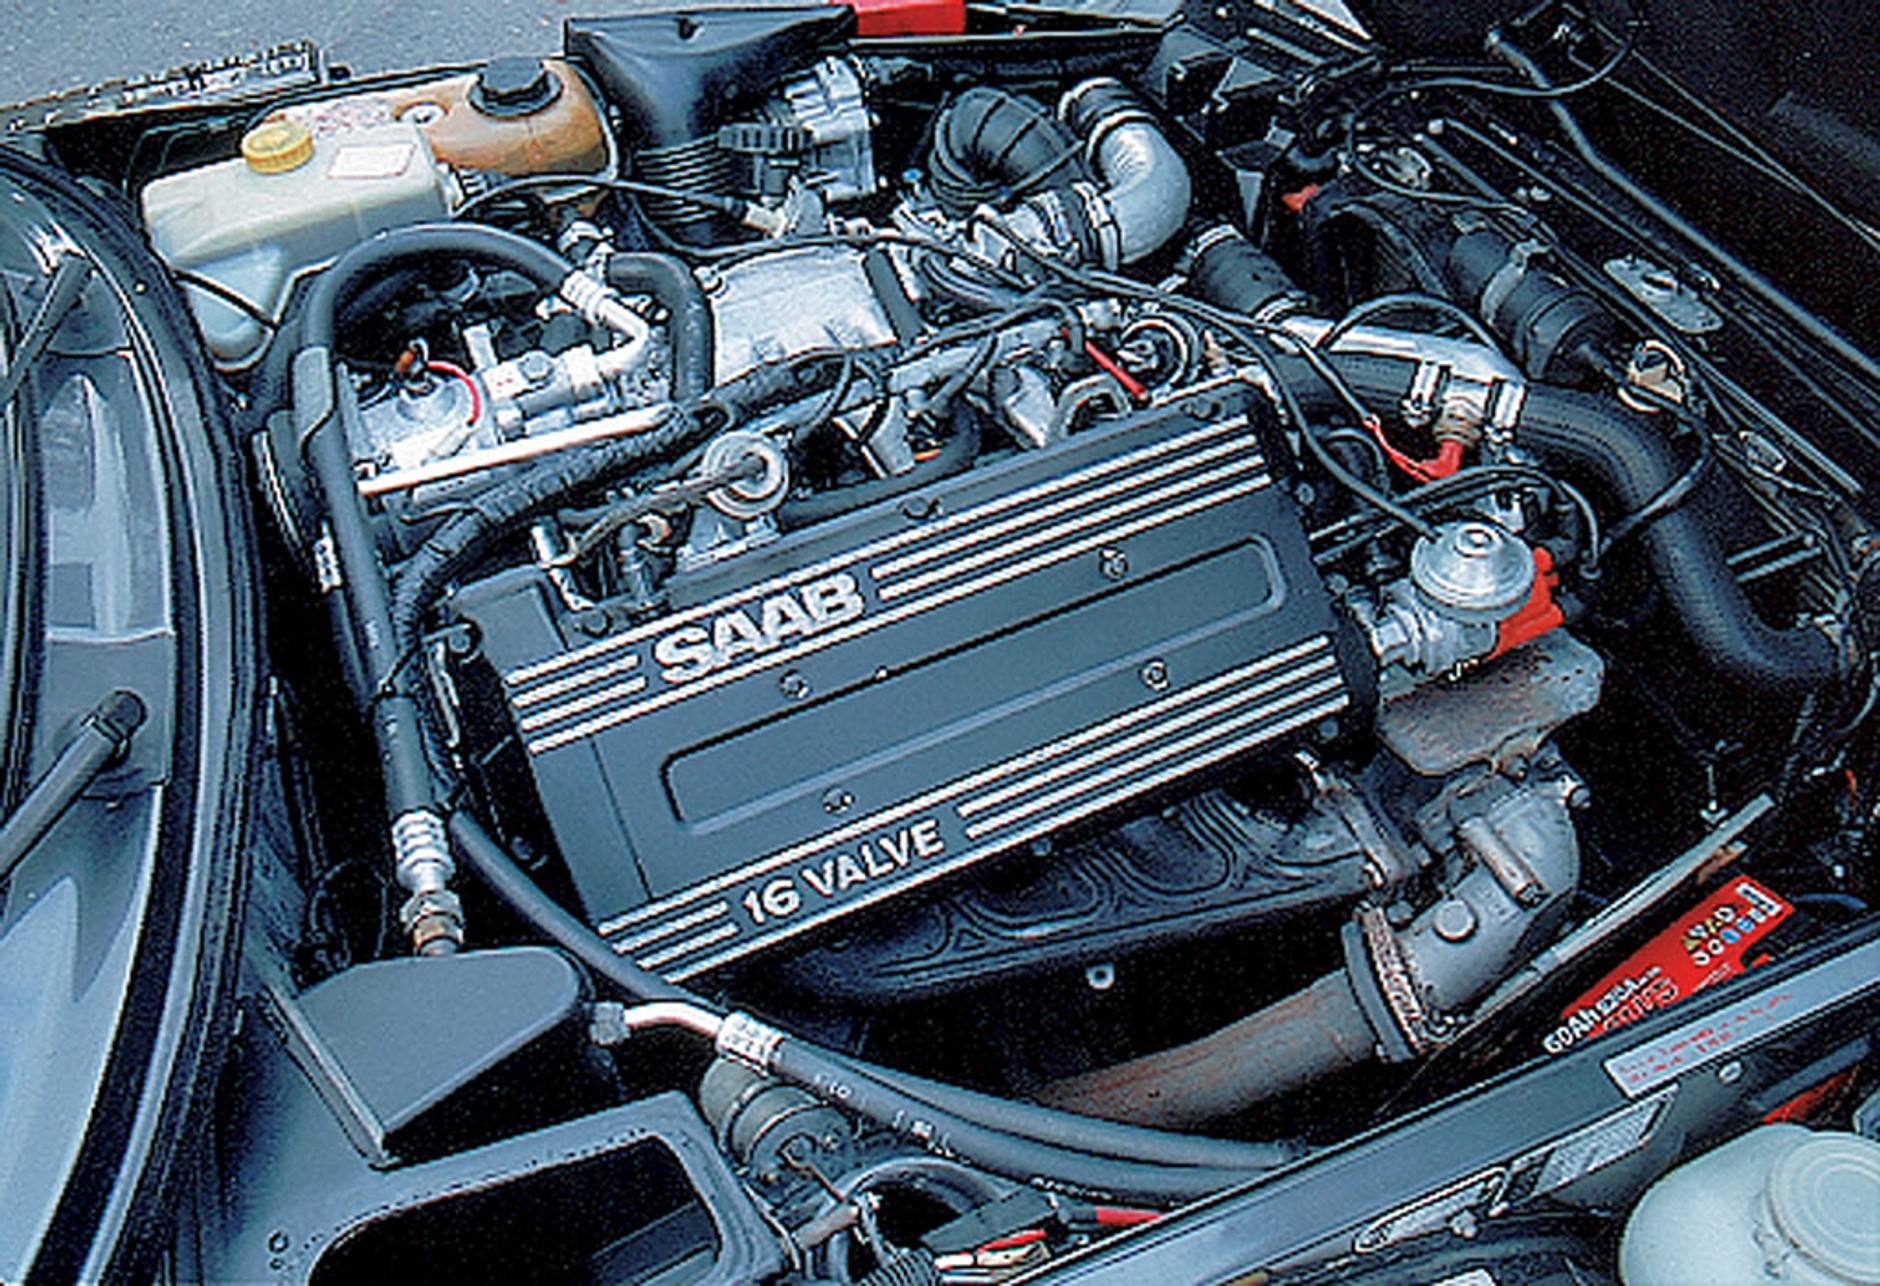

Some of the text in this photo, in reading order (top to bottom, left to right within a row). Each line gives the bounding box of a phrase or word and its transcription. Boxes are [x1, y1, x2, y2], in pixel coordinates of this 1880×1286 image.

[654, 573, 864, 684] SAAB
[744, 819, 945, 924] 16 VALVE
